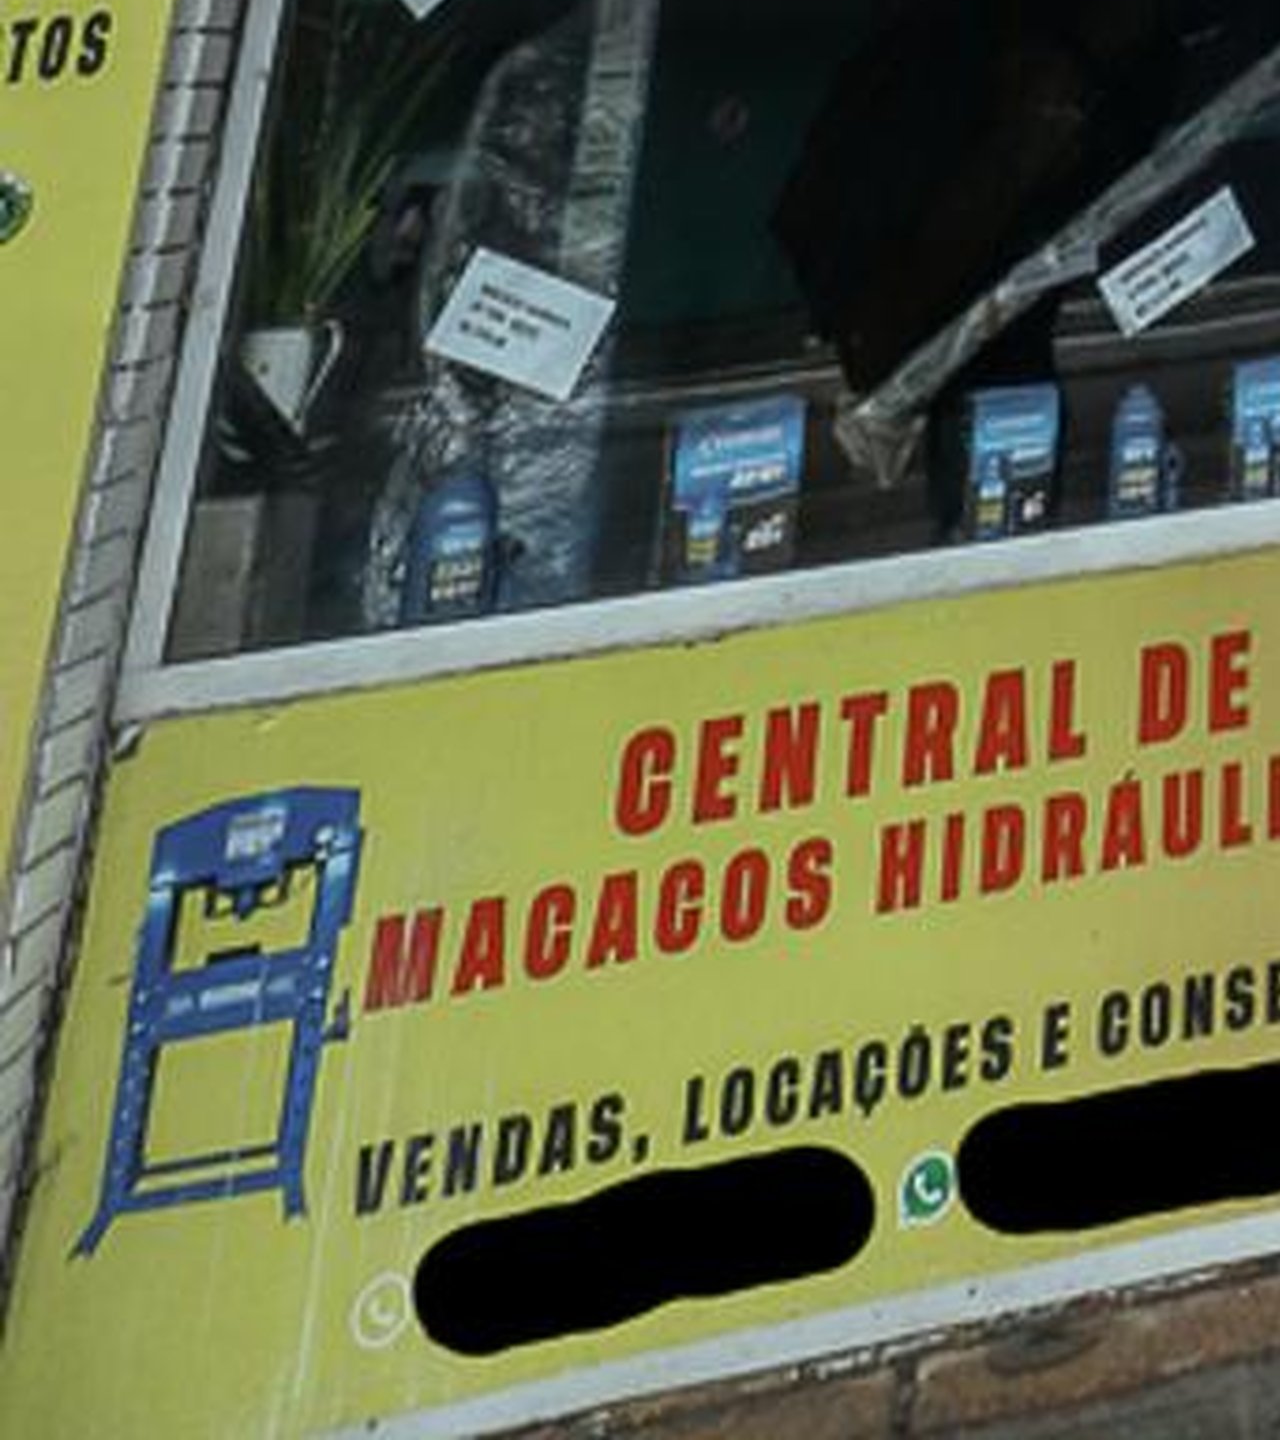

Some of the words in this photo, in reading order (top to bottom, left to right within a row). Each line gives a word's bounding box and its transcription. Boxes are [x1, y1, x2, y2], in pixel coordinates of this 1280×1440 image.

[614, 658, 1086, 836] CENTRAL
[1137, 629, 1252, 747] DE
[362, 838, 834, 1014] MACACOS
[354, 1094, 649, 1216] VENDAS,
[683, 1015, 1013, 1145] LOCAÇÕES
[1041, 1002, 1071, 1070] E
